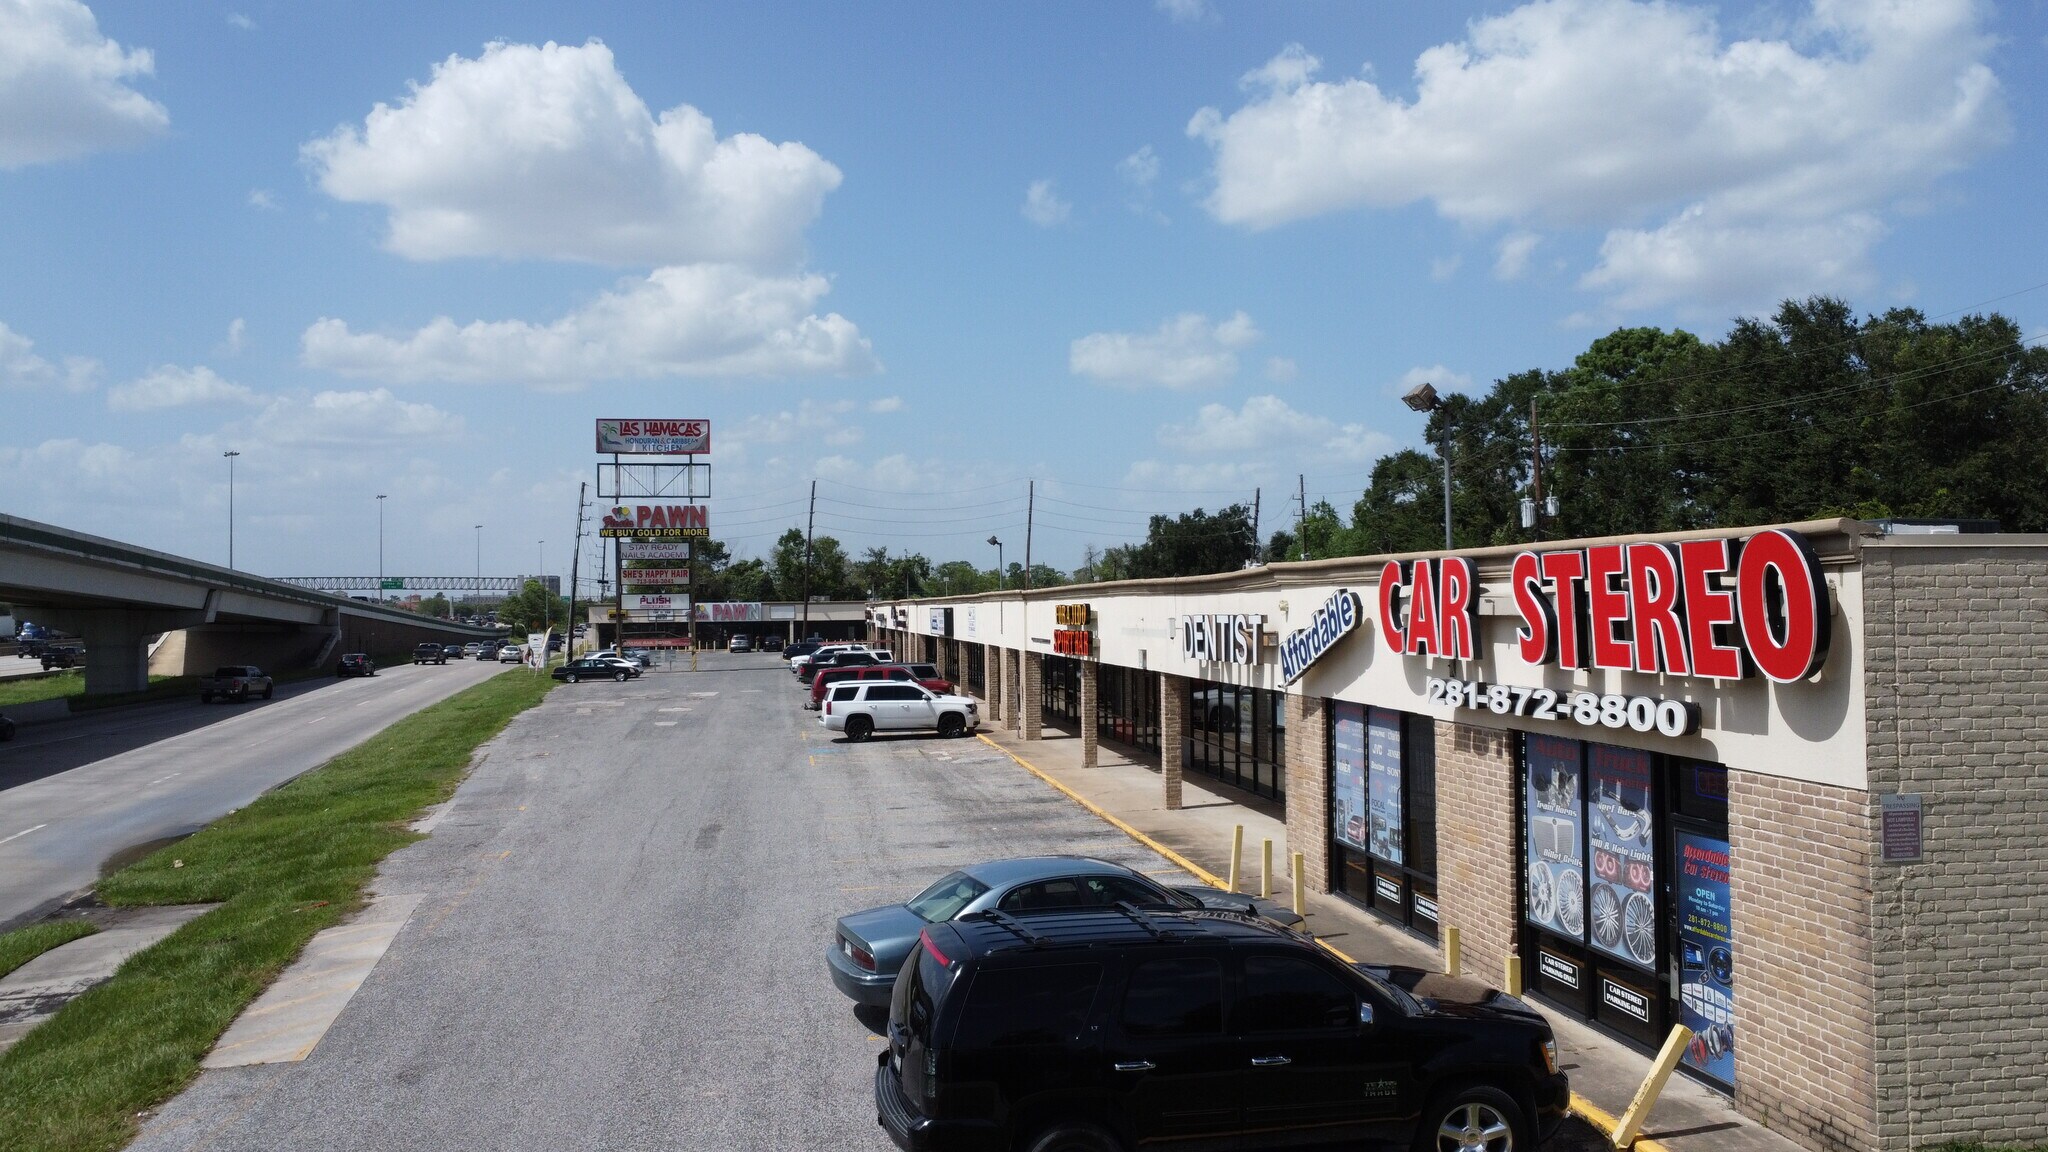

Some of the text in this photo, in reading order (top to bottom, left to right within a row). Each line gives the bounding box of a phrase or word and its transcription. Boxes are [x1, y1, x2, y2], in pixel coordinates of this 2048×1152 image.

[619, 421, 702, 437] LAS HAMACAS
[642, 444, 682, 452] KITCHEN
[636, 505, 707, 529] PAWN
[600, 529, 708, 537] WE BUY GOLD FOR MORE
[622, 569, 689, 579] SHE'S HAPPY HAIR
[639, 596, 671, 605] PLUSH
[1379, 531, 1820, 684] CAR STEREO
[712, 603, 760, 621] PAWN
[1183, 614, 1263, 666] DENTIST
[1279, 590, 1356, 686] Affordable
[1428, 678, 1688, 737] 281-872-8800
[1695, 887, 1716, 902] OPEN
[1544, 956, 1555, 968] CAR
[1542, 963, 1576, 984] PARKING ONLY
[1609, 984, 1621, 997] CAR
[1606, 992, 1646, 1017] PARKING ONLY
